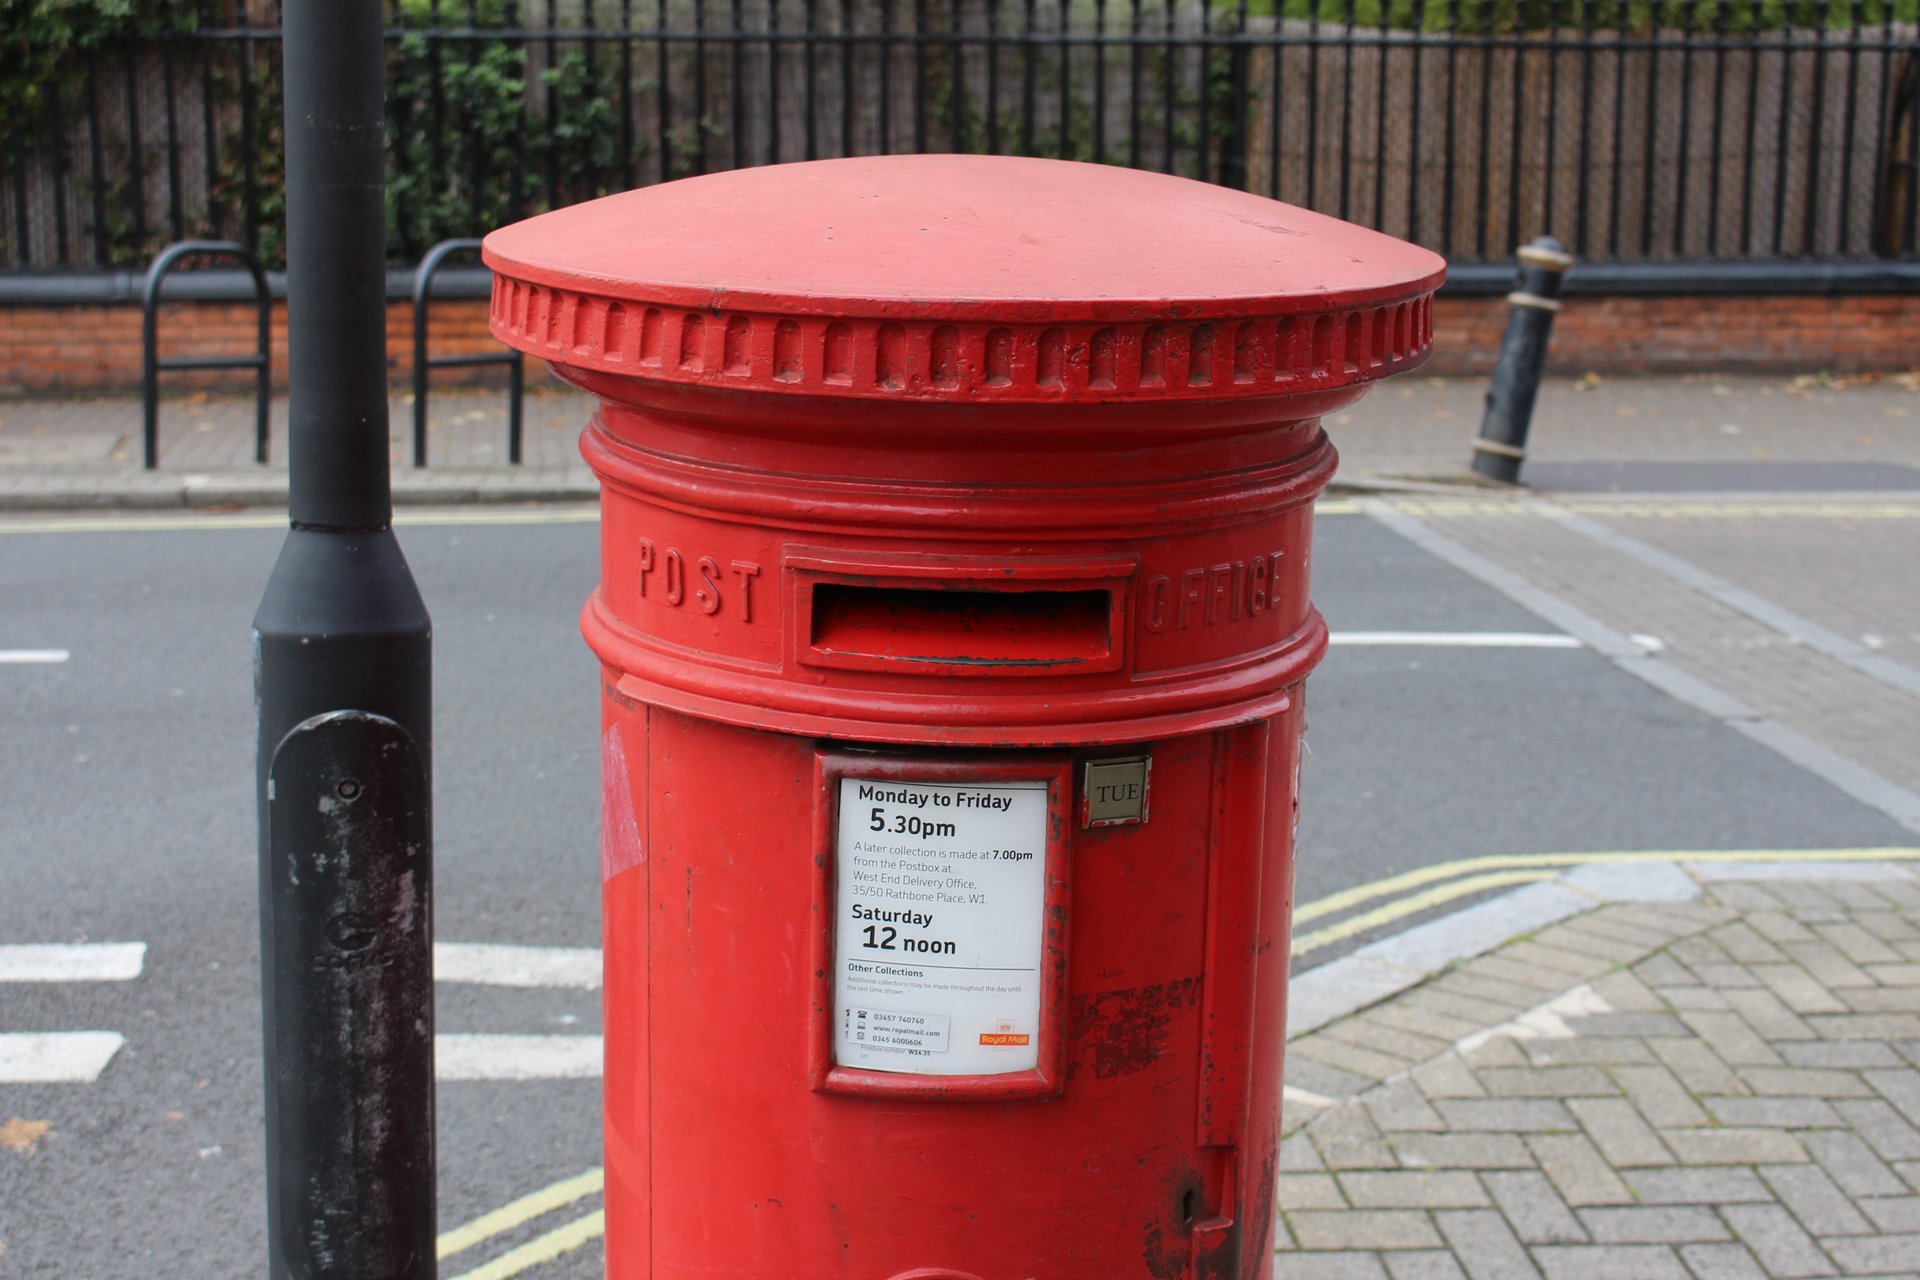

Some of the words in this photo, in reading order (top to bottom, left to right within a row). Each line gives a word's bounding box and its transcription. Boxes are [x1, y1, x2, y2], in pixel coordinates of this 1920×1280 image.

[637, 537, 760, 624] POST
[1146, 550, 1285, 633] OFFICE
[859, 785, 928, 809] Monday
[933, 794, 951, 807] to
[956, 792, 1012, 811] Friday
[1096, 783, 1139, 803] TUE
[869, 808, 956, 839] 5.30pm
[854, 842, 862, 851] A
[863, 842, 887, 854] later
[889, 844, 937, 858] collection
[938, 847, 947, 859] is
[949, 849, 977, 860] made
[980, 851, 990, 860] at
[992, 850, 1033, 862] 7.00pm
[853, 856, 878, 868] from
[880, 858, 896, 870] the
[899, 860, 939, 873] Postbox
[941, 863, 951, 873] at
[852, 870, 880, 882] West
[881, 872, 900, 885] End
[903, 875, 944, 889] Delivery
[946, 878, 977, 890] Office,
[852, 885, 884, 898] 35/50
[886, 889, 934, 902] Rathbone
[936, 892, 966, 904] Place,
[851, 904, 933, 928] Saturday
[862, 925, 897, 950] 12
[903, 938, 956, 955] noon
[848, 963, 874, 973] Other
[875, 965, 924, 977] Collections
[847, 976, 877, 984] Additional
[878, 979, 909, 987] collections
[950, 984, 984, 992] throughout
[874, 1013, 896, 1021] 03457
[898, 1015, 924, 1024] 740740
[872, 1035, 890, 1043] 0345
[892, 1037, 923, 1046] 6000606
[873, 1025, 941, 1037] www.royalmail.com
[982, 1035, 1006, 1045] Royal
[1008, 1035, 1028, 1043] Mail
